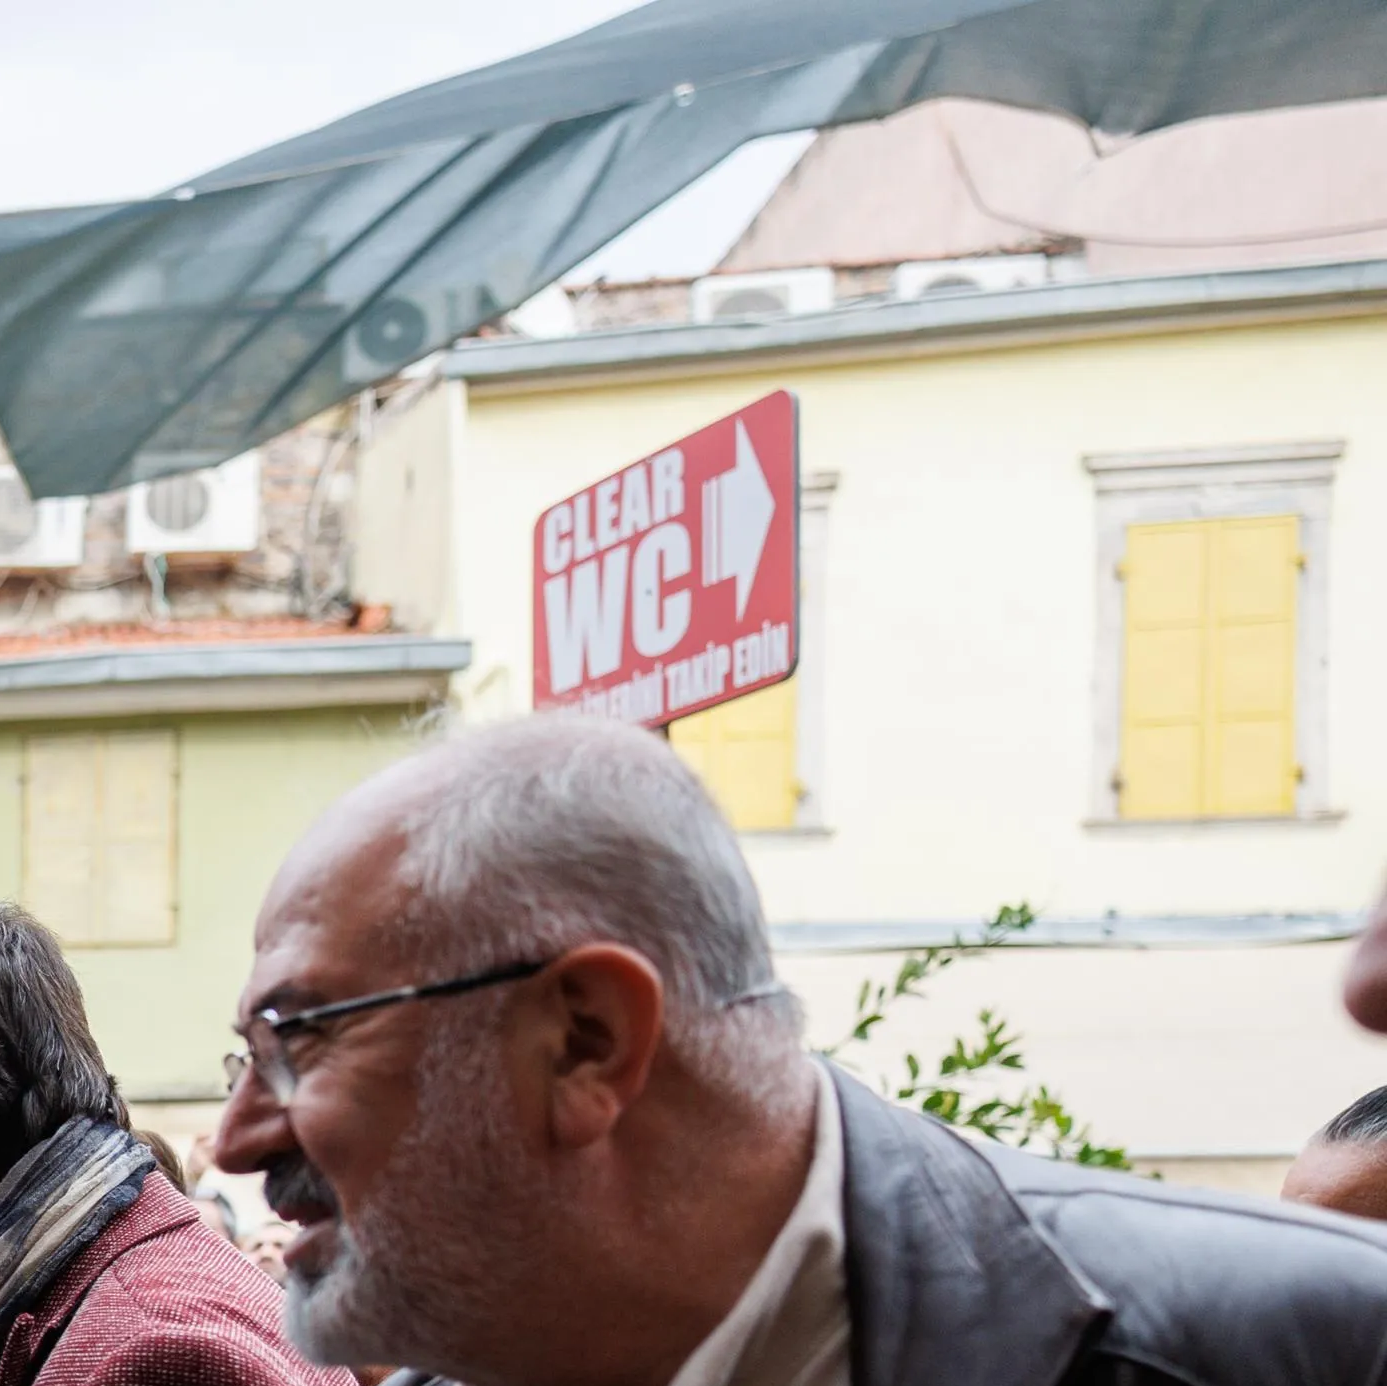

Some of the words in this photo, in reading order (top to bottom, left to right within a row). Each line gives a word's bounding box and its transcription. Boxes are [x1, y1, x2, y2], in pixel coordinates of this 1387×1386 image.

[543, 447, 685, 574] CLEAR
[543, 522, 692, 695] WC
[664, 640, 731, 712] TAKİP
[732, 618, 789, 688] EDİN
